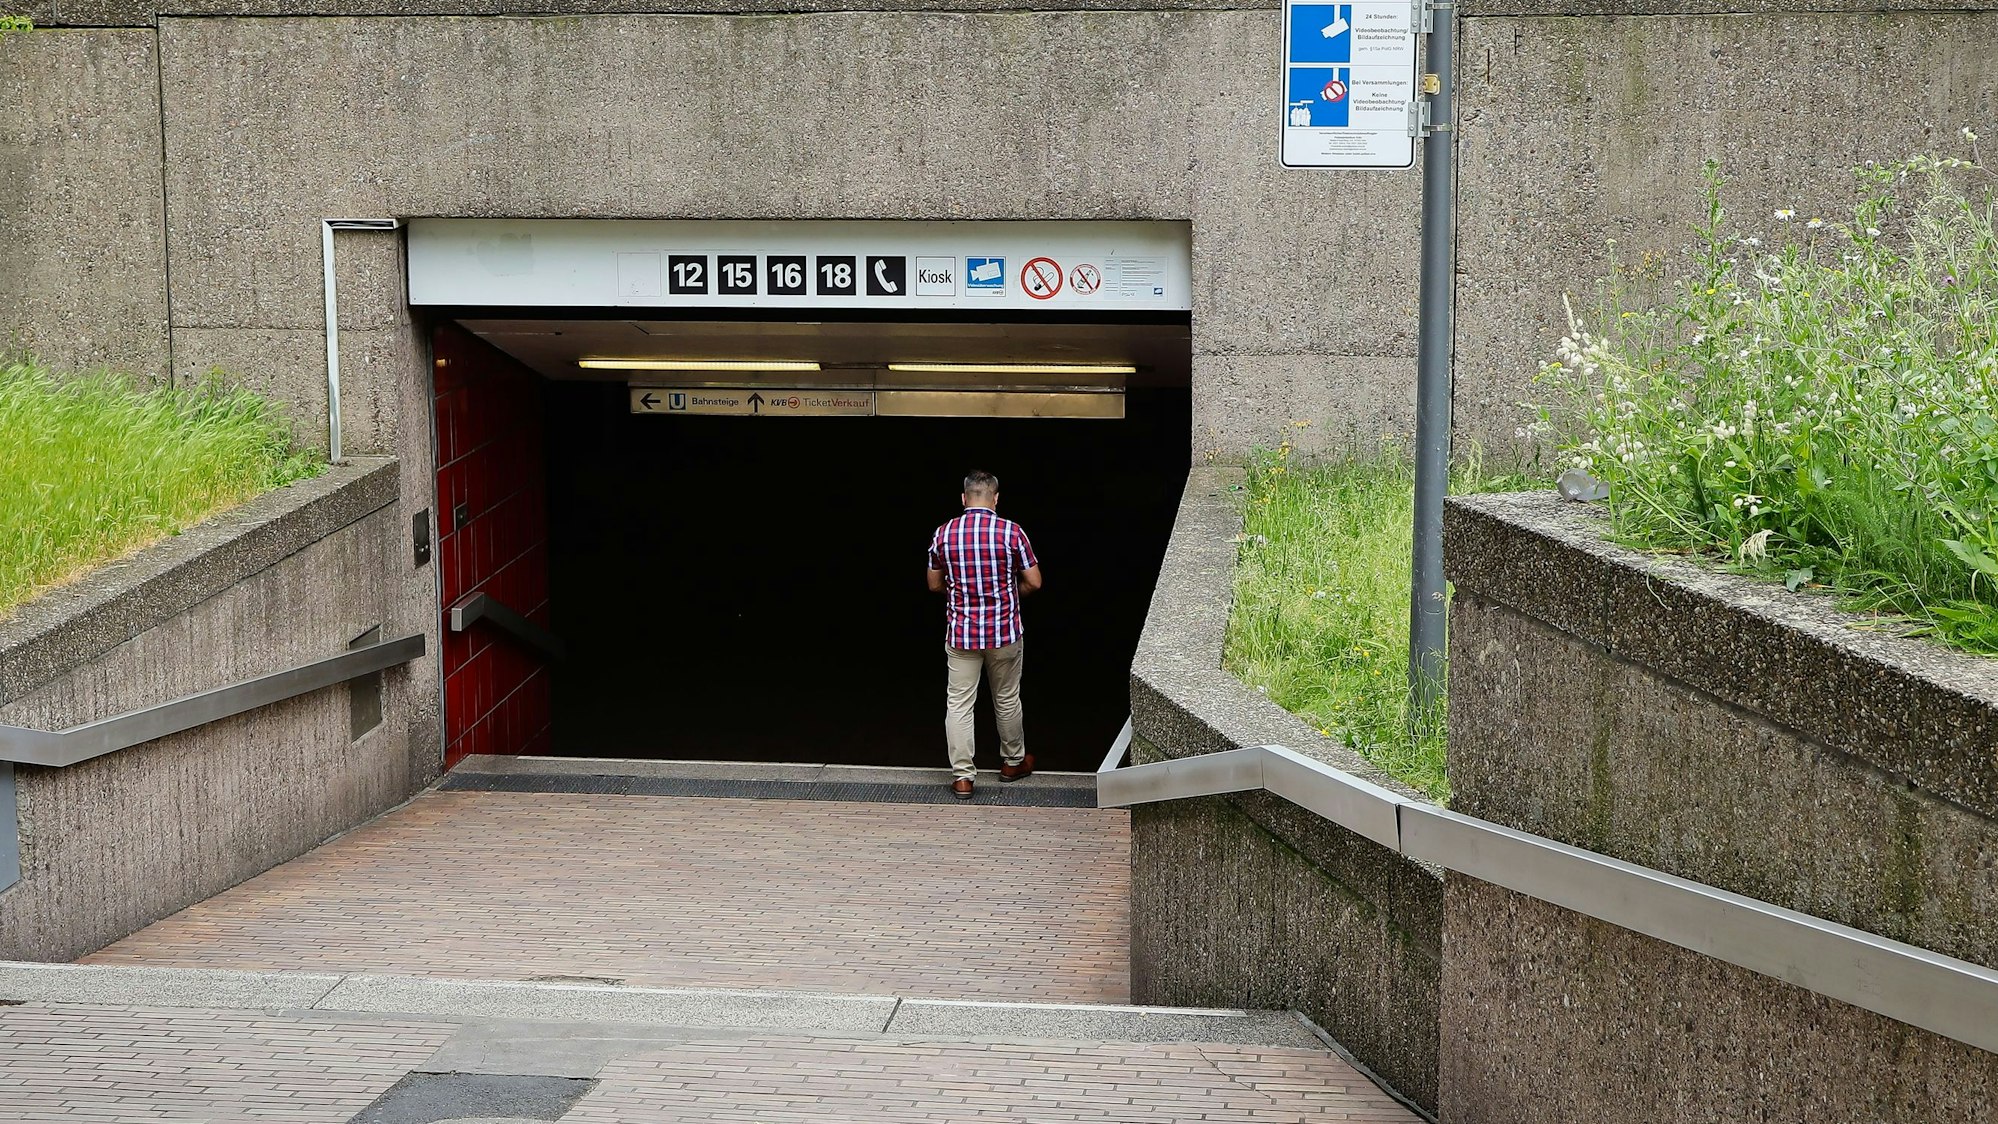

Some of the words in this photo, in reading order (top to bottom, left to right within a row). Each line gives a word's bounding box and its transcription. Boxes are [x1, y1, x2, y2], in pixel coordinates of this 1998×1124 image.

[673, 262, 704, 288] 12
[722, 263, 753, 288] 15
[771, 263, 802, 288] 16
[820, 263, 852, 288] 18
[919, 269, 952, 283] Kiosk
[669, 394, 685, 409] U
[692, 397, 739, 407] Bahnsteige
[803, 398, 869, 408] TicketVerkauf
